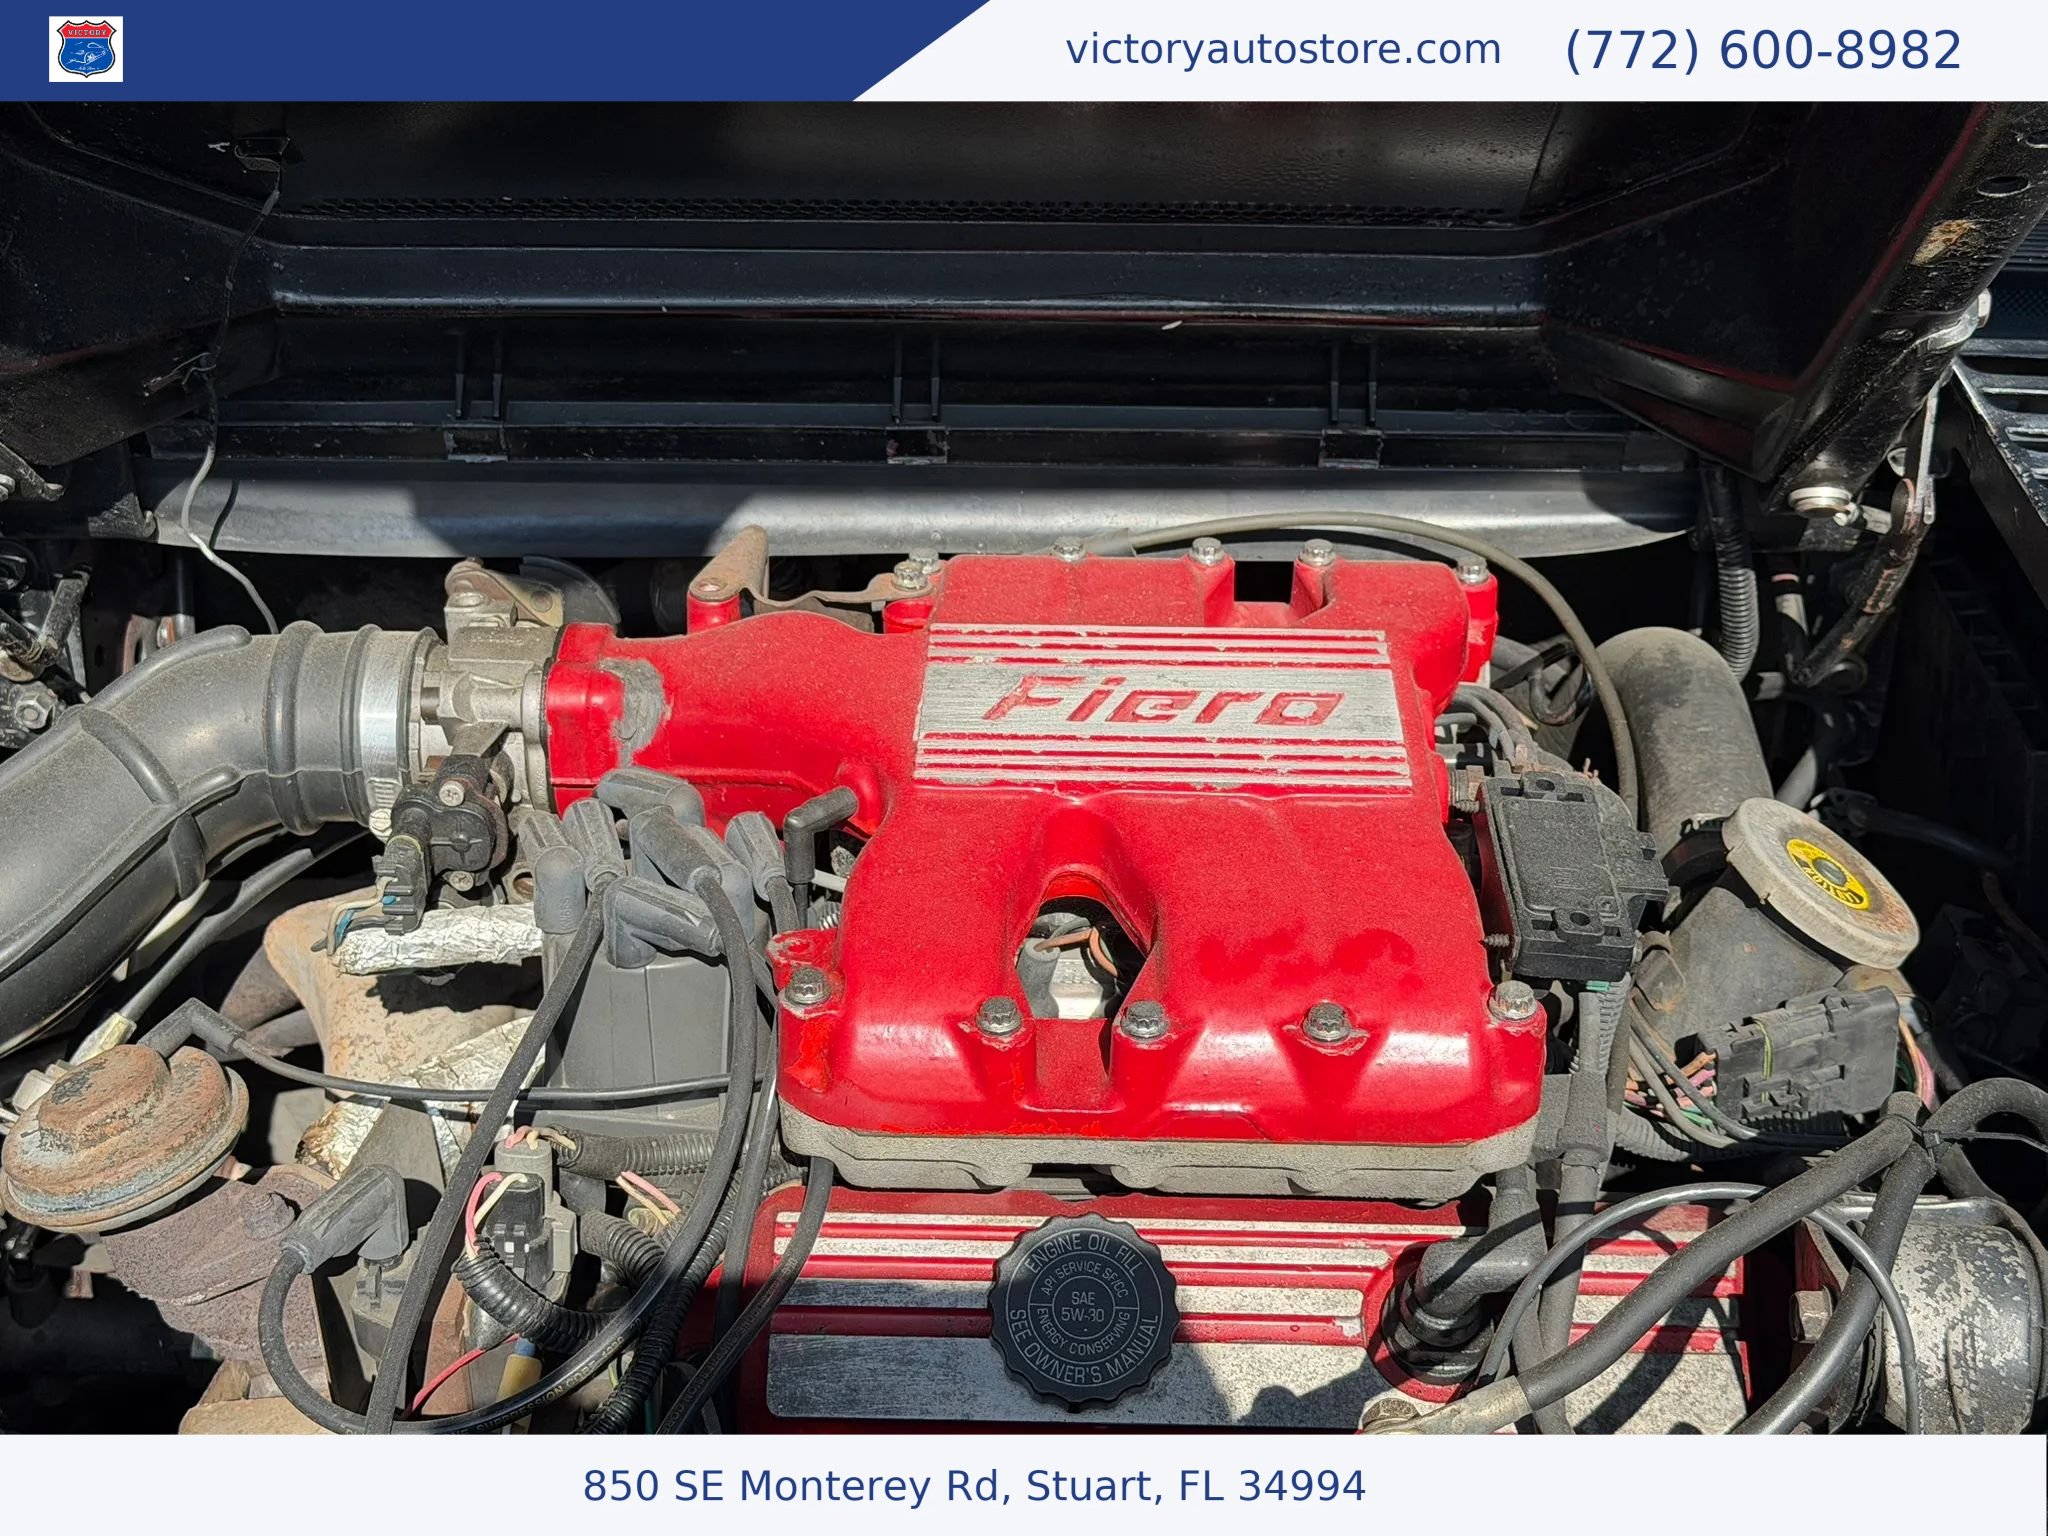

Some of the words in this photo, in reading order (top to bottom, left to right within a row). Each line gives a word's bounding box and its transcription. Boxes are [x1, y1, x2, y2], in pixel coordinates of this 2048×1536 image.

[983, 675, 1346, 726] Fiero
[1024, 1233, 1082, 1274] ENGINE
[1087, 1233, 1110, 1255] OIL
[1114, 1245, 1143, 1277] FILL
[1041, 1275, 1057, 1296] API
[1055, 1260, 1102, 1279] SERVICE
[1102, 1267, 1129, 1298] SF/CC
[1071, 1291, 1096, 1305] SAE
[1037, 1308, 1068, 1349] ENERGY
[1069, 1311, 1131, 1356] CONSERVING
[1061, 1307, 1105, 1322] 5W-30
[1010, 1309, 1032, 1342] SEE
[1024, 1342, 1102, 1384] OWNER'S
[1105, 1315, 1158, 1377] MANUAL
[476, 1385, 564, 1432] SUPPRESSION
